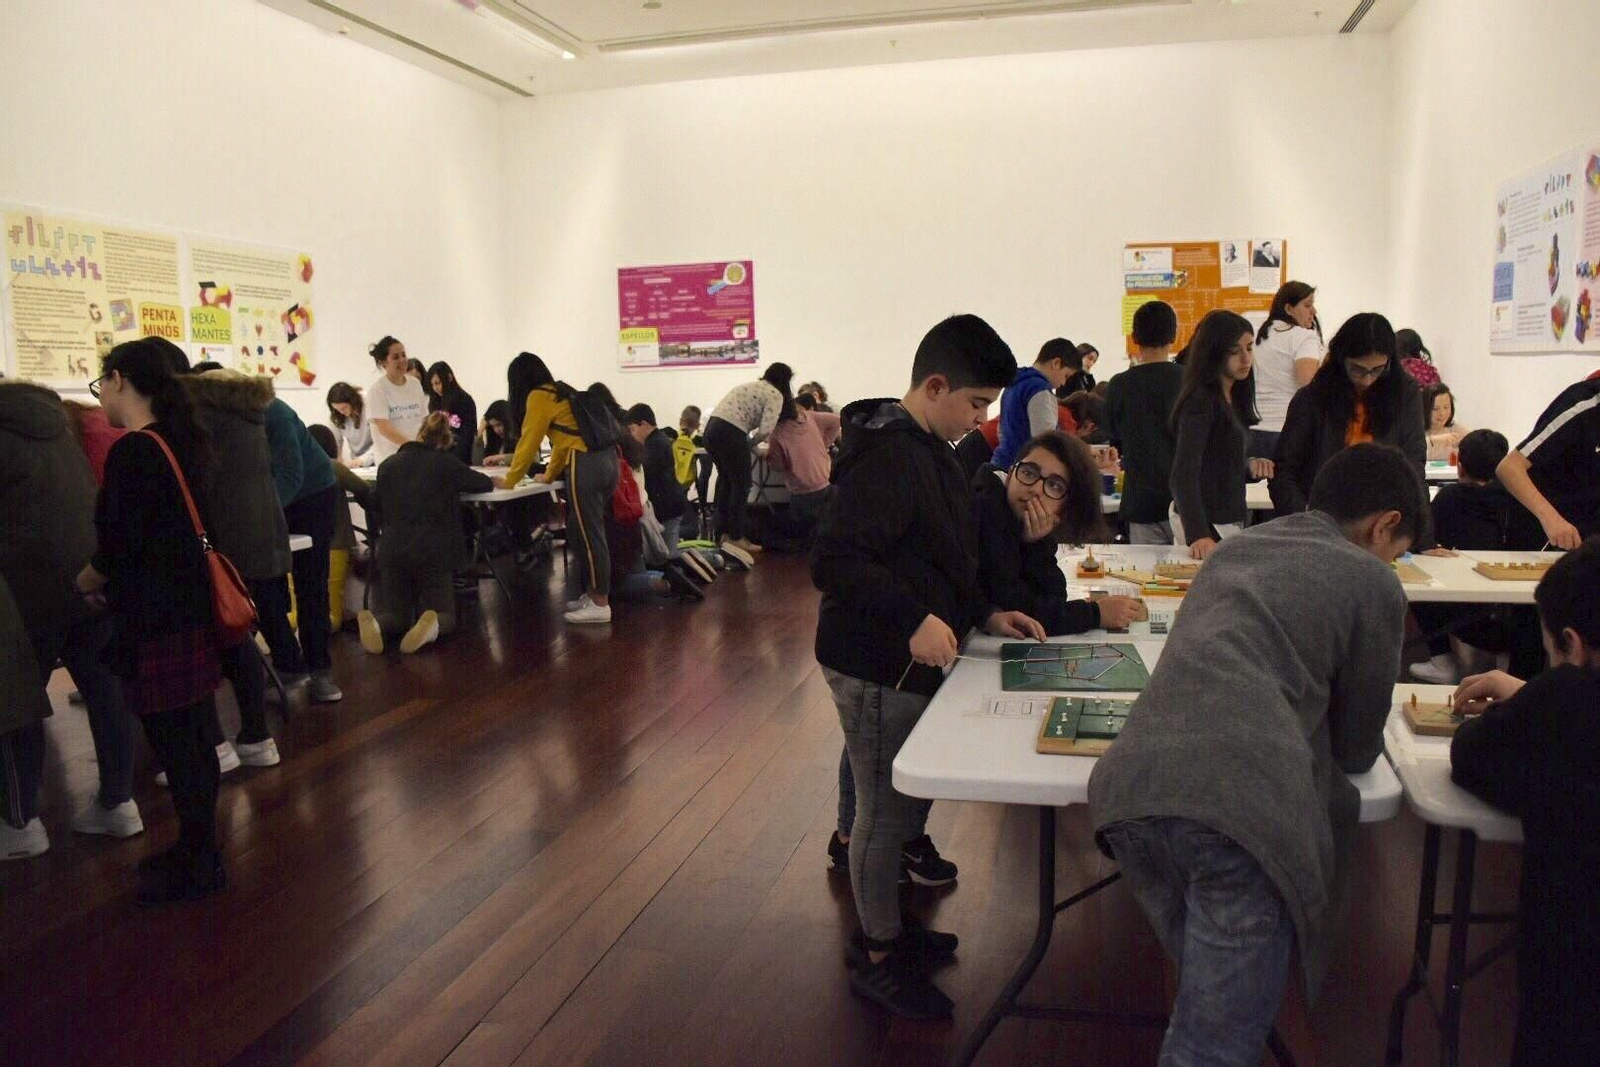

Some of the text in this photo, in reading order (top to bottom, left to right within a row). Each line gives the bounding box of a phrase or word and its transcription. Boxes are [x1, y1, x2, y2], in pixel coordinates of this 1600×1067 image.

[141, 307, 177, 323] PENTA
[191, 312, 217, 325] HEXA
[192, 327, 231, 341] MANTES
